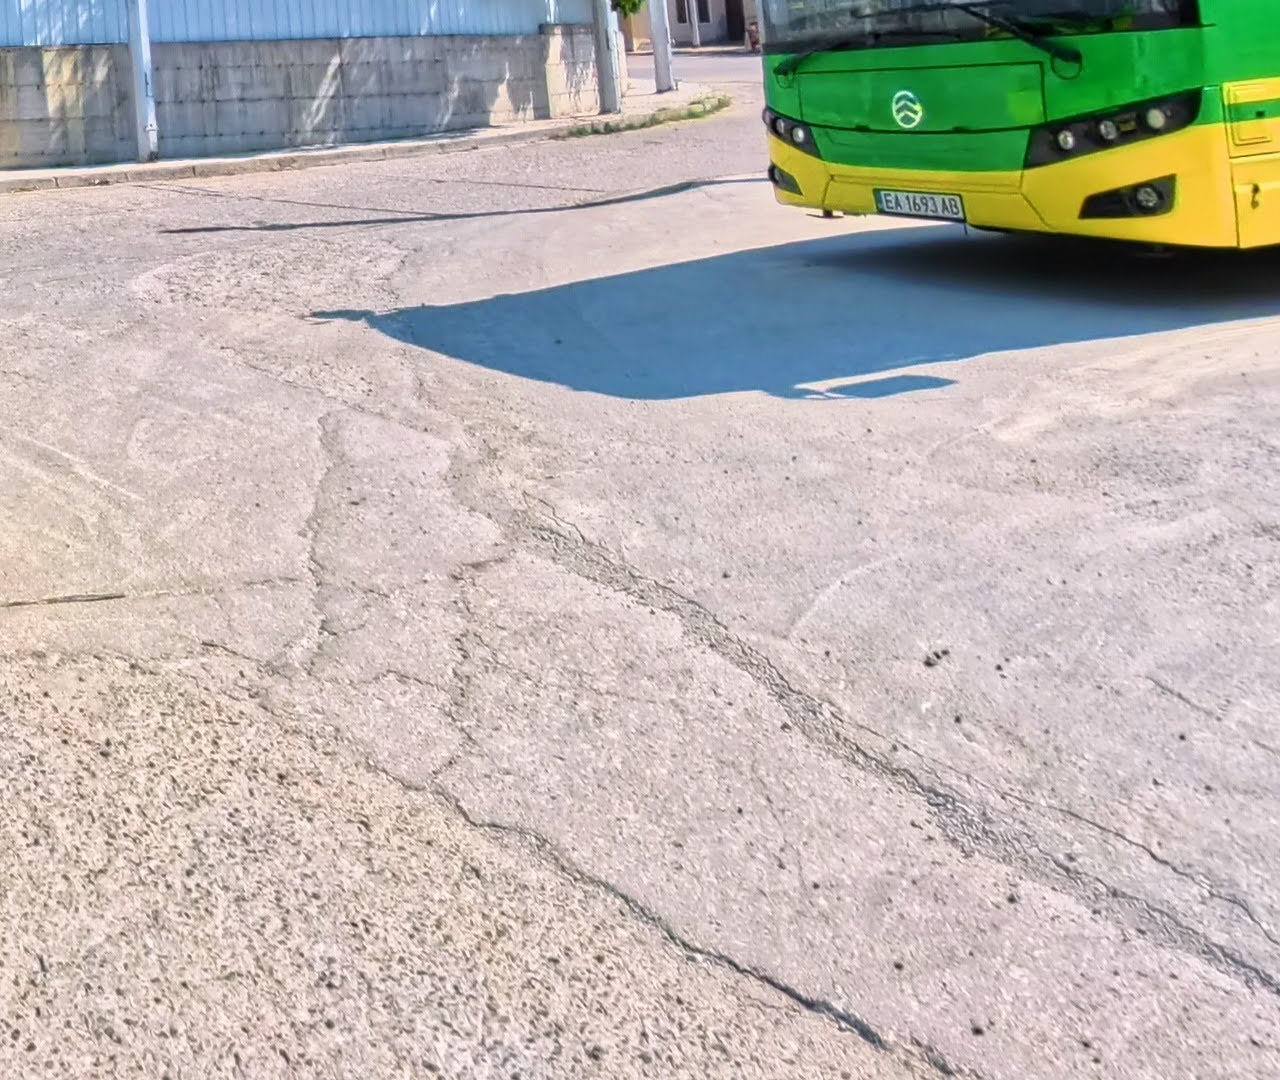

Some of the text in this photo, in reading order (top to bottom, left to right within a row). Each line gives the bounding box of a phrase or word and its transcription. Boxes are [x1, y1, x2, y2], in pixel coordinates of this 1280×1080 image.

[883, 193, 960, 215] EA 1693 AB
